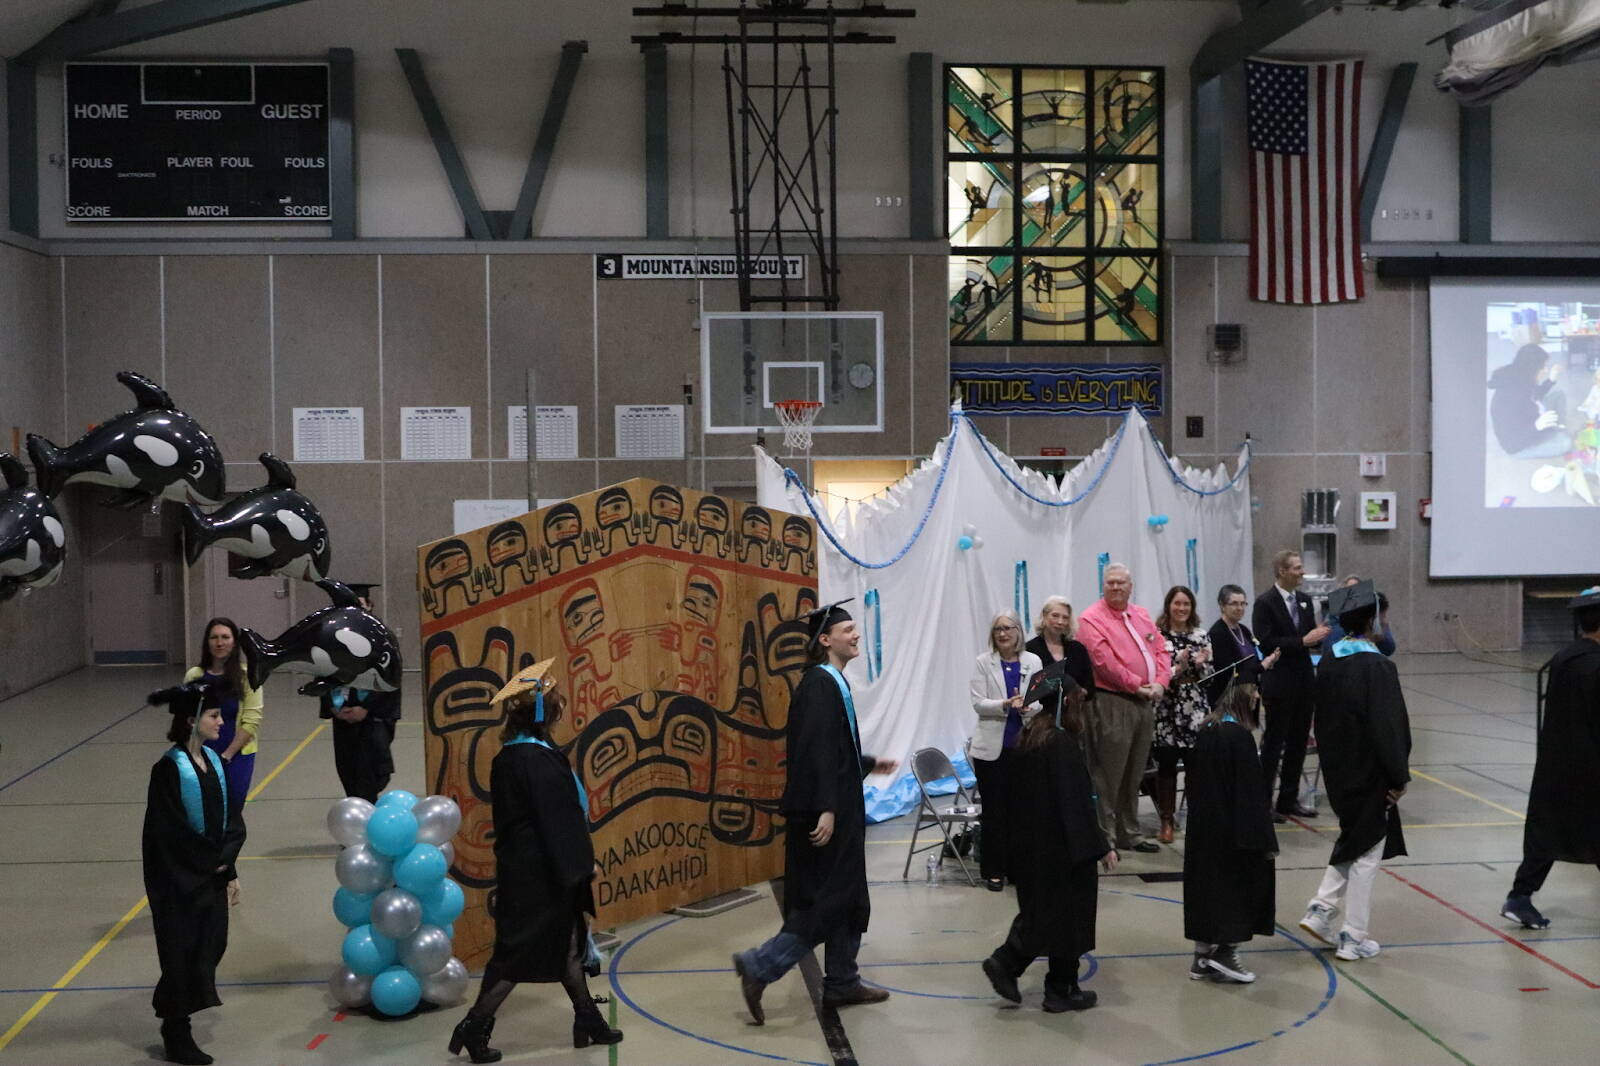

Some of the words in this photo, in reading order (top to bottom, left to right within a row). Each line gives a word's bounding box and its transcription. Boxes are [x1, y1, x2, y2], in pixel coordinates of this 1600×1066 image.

[74, 103, 129, 119] HOME
[175, 109, 222, 121] PERIOD
[260, 104, 324, 120] GUEST
[71, 157, 113, 169] FOULS
[167, 157, 214, 168] PLAYER
[220, 157, 253, 168] FOUL
[284, 157, 326, 169] FOULS
[67, 206, 111, 217] SCORE
[187, 206, 230, 217] MATCH
[284, 206, 329, 217] SCORE
[603, 259, 616, 275] 3
[627, 259, 746, 275] MOUNTANSID
[1057, 376, 1158, 408] EVERYTHING
